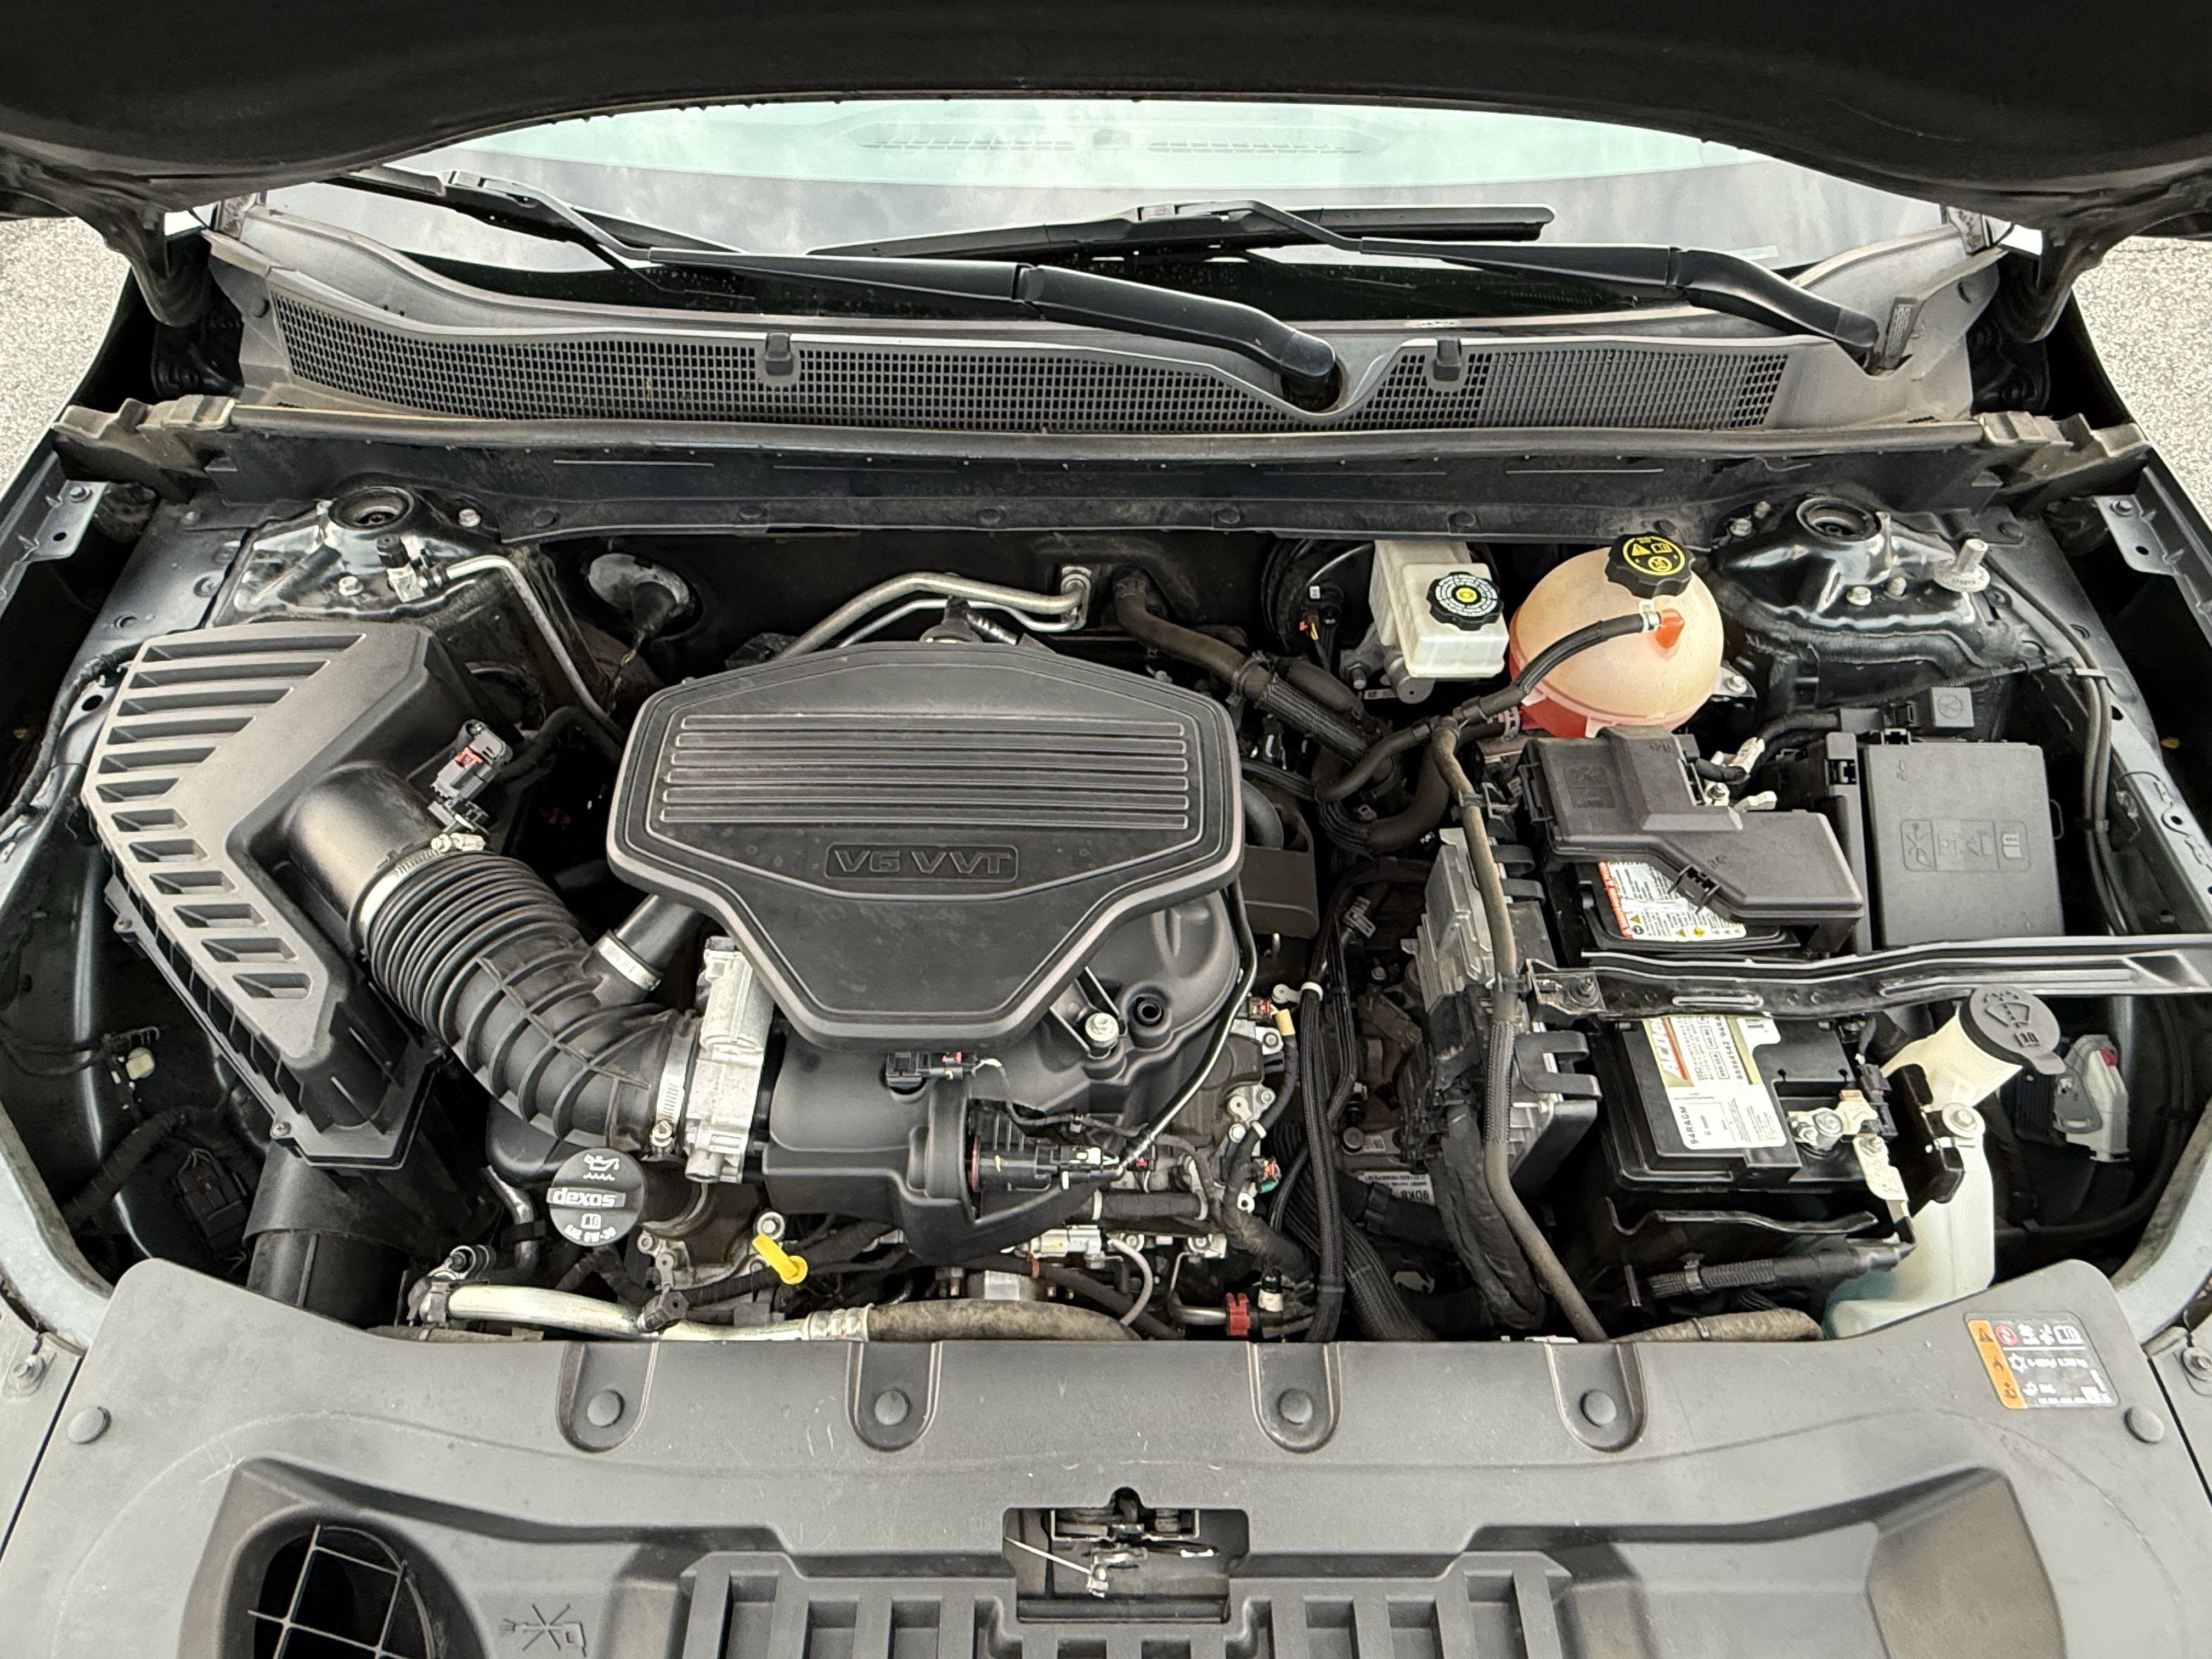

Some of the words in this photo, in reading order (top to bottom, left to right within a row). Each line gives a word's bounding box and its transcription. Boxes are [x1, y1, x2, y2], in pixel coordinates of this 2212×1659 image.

[833, 850, 901, 873] V6
[911, 850, 1011, 874] VVT
[1650, 1018, 1683, 1079] ACDe
[1679, 1105, 1697, 1144] 94RAGM
[553, 1187, 616, 1207] dexos
